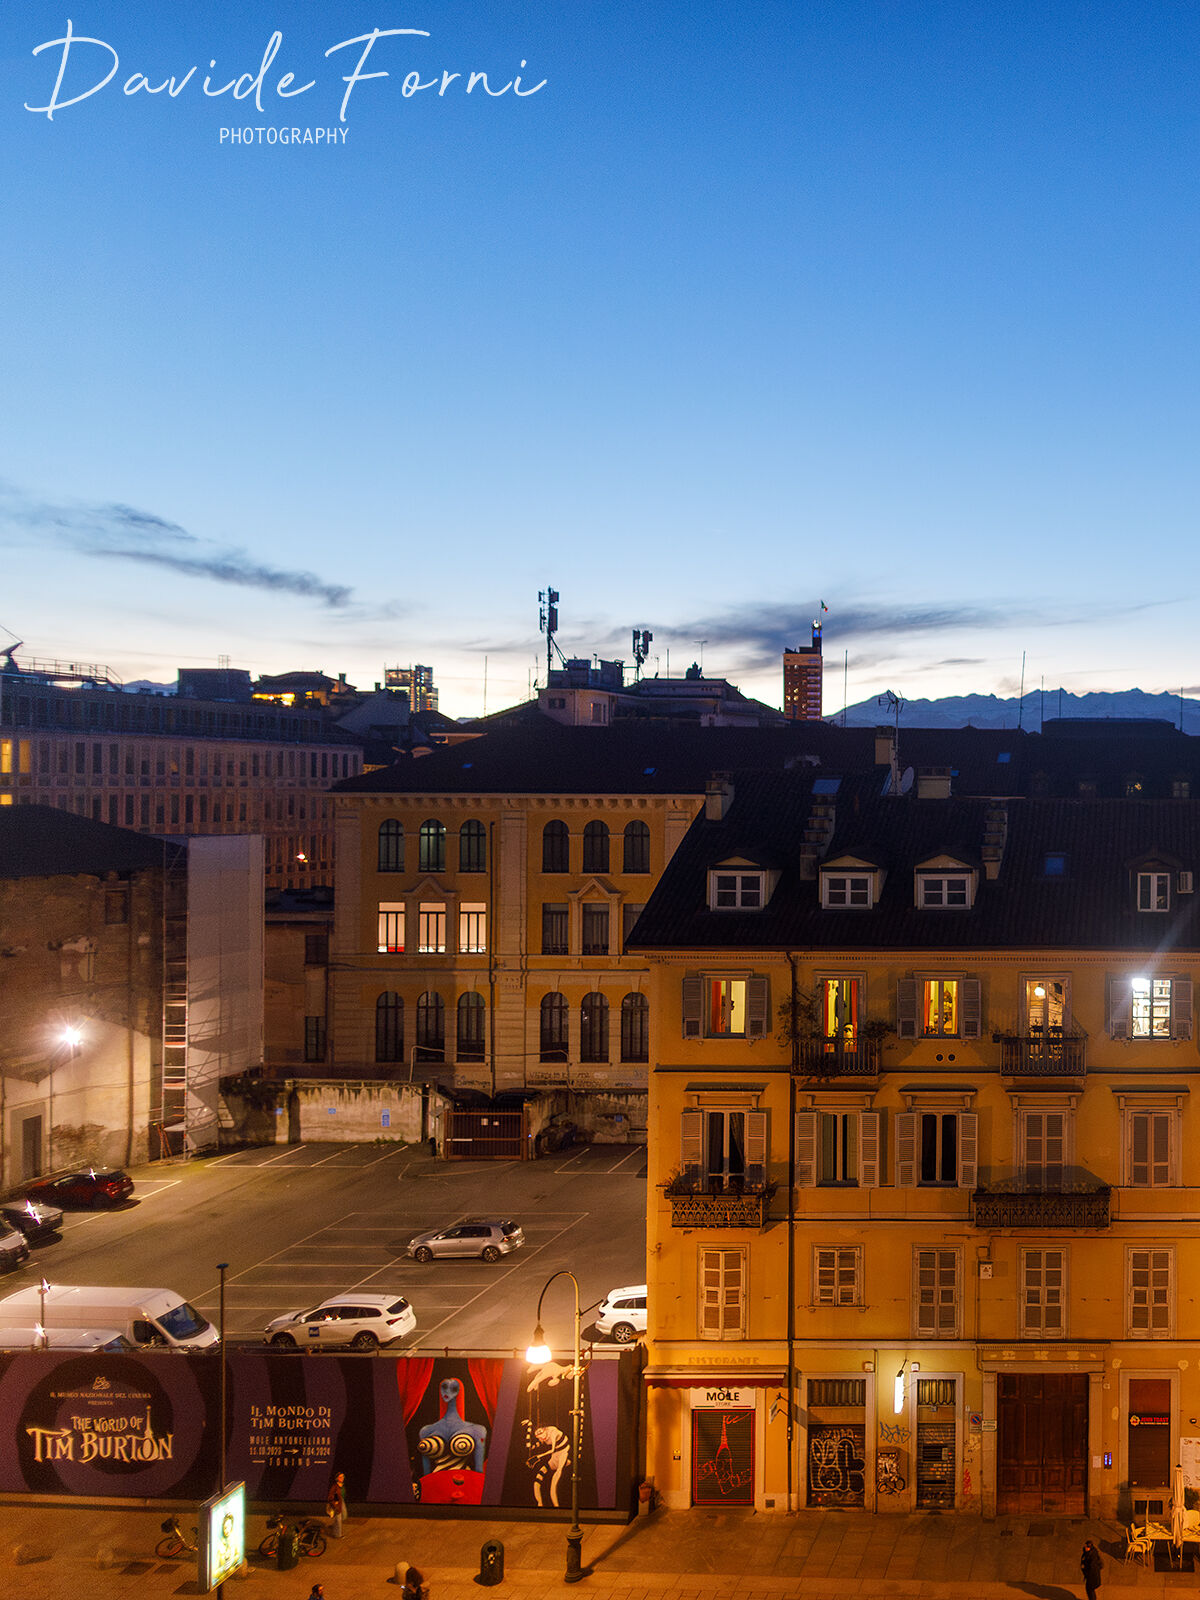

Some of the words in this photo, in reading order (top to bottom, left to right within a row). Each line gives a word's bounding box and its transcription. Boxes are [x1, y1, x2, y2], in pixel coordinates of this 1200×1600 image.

[706, 1392, 740, 1401] MOLE
[251, 1405, 263, 1417] IL
[266, 1405, 315, 1418] MONDO
[318, 1406, 331, 1417] DI
[71, 1416, 93, 1431] THE
[93, 1417, 129, 1433] WORLD
[129, 1416, 144, 1431] OF
[250, 1418, 274, 1430] TIM
[278, 1418, 331, 1430] BURTON
[26, 1427, 75, 1463] TIM
[78, 1431, 174, 1464] BURTON
